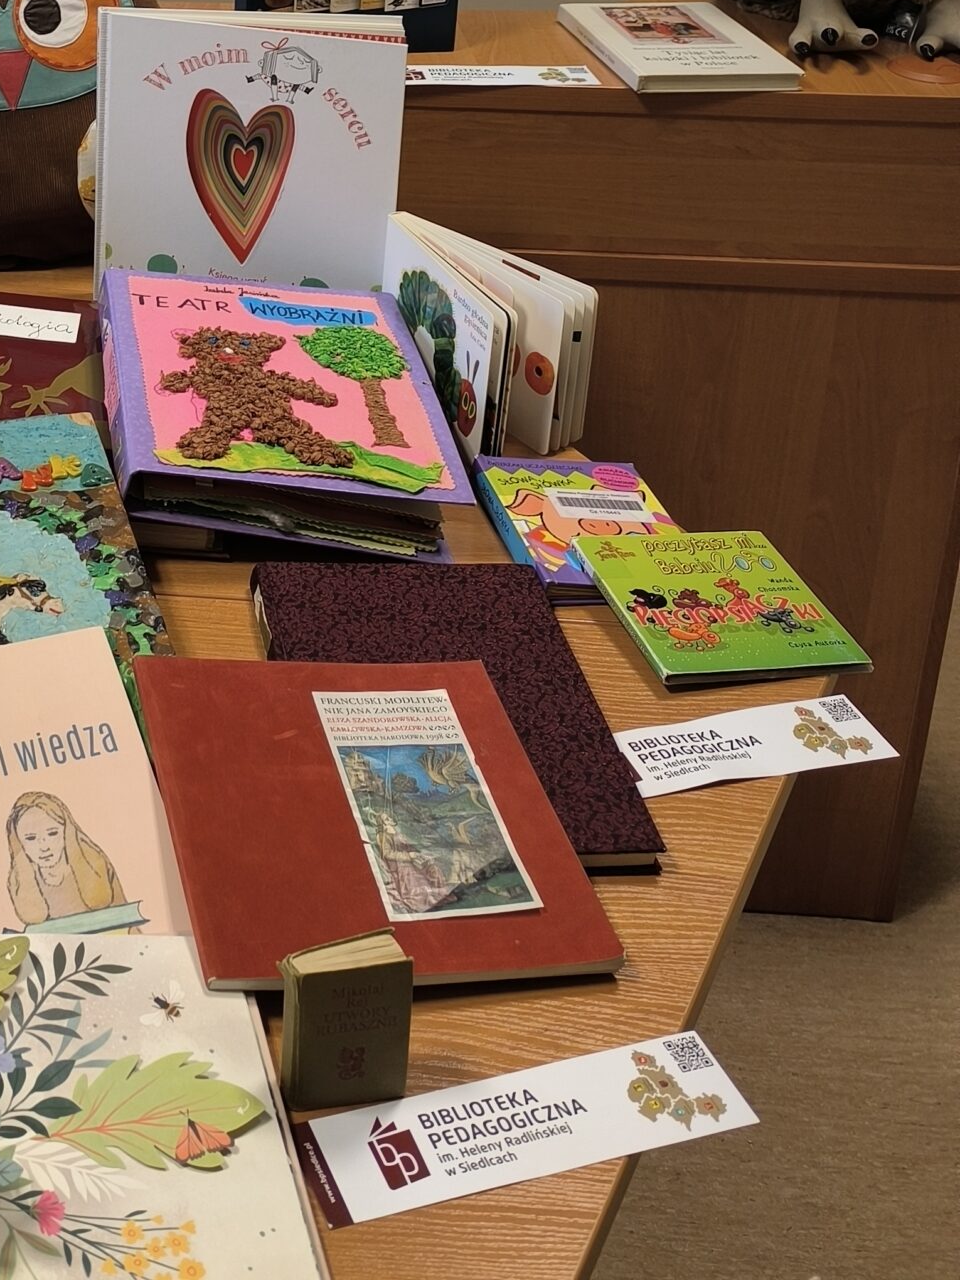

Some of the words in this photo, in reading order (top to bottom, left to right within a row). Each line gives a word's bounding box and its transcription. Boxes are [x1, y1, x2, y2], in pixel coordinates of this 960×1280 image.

[143, 62, 173, 91] W
[178, 43, 251, 76] moim
[322, 87, 372, 151] sercu
[641, 536, 732, 557] poczytasz
[758, 585, 800, 593] Chotomska
[814, 639, 847, 647] Autorka
[320, 697, 382, 705] FRANCUSKI
[384, 696, 448, 705] MODLITEW-
[324, 707, 343, 715] NIK
[346, 707, 372, 716] JANA
[374, 706, 448, 715] ZAMOYSKIEGO
[13, 722, 119, 773] wiedza
[380, 733, 424, 741] NARODOWA
[628, 729, 723, 753] BIBLIOTEKA
[638, 735, 762, 764] PEDAGOGICZNA
[646, 765, 662, 773] im.
[664, 757, 698, 770] Heleny
[699, 751, 752, 762] Radlińskiej
[664, 763, 711, 778] Siedlcach
[418, 1089, 538, 1130] BIBLIOTEKA
[428, 1098, 588, 1149] PEDAGOGICZNA
[437, 1153, 458, 1163] im.
[459, 1141, 502, 1159] Heleny
[504, 1122, 573, 1148] Radlińskiej
[445, 1168, 456, 1177] w
[459, 1151, 518, 1173] Siedlcach
